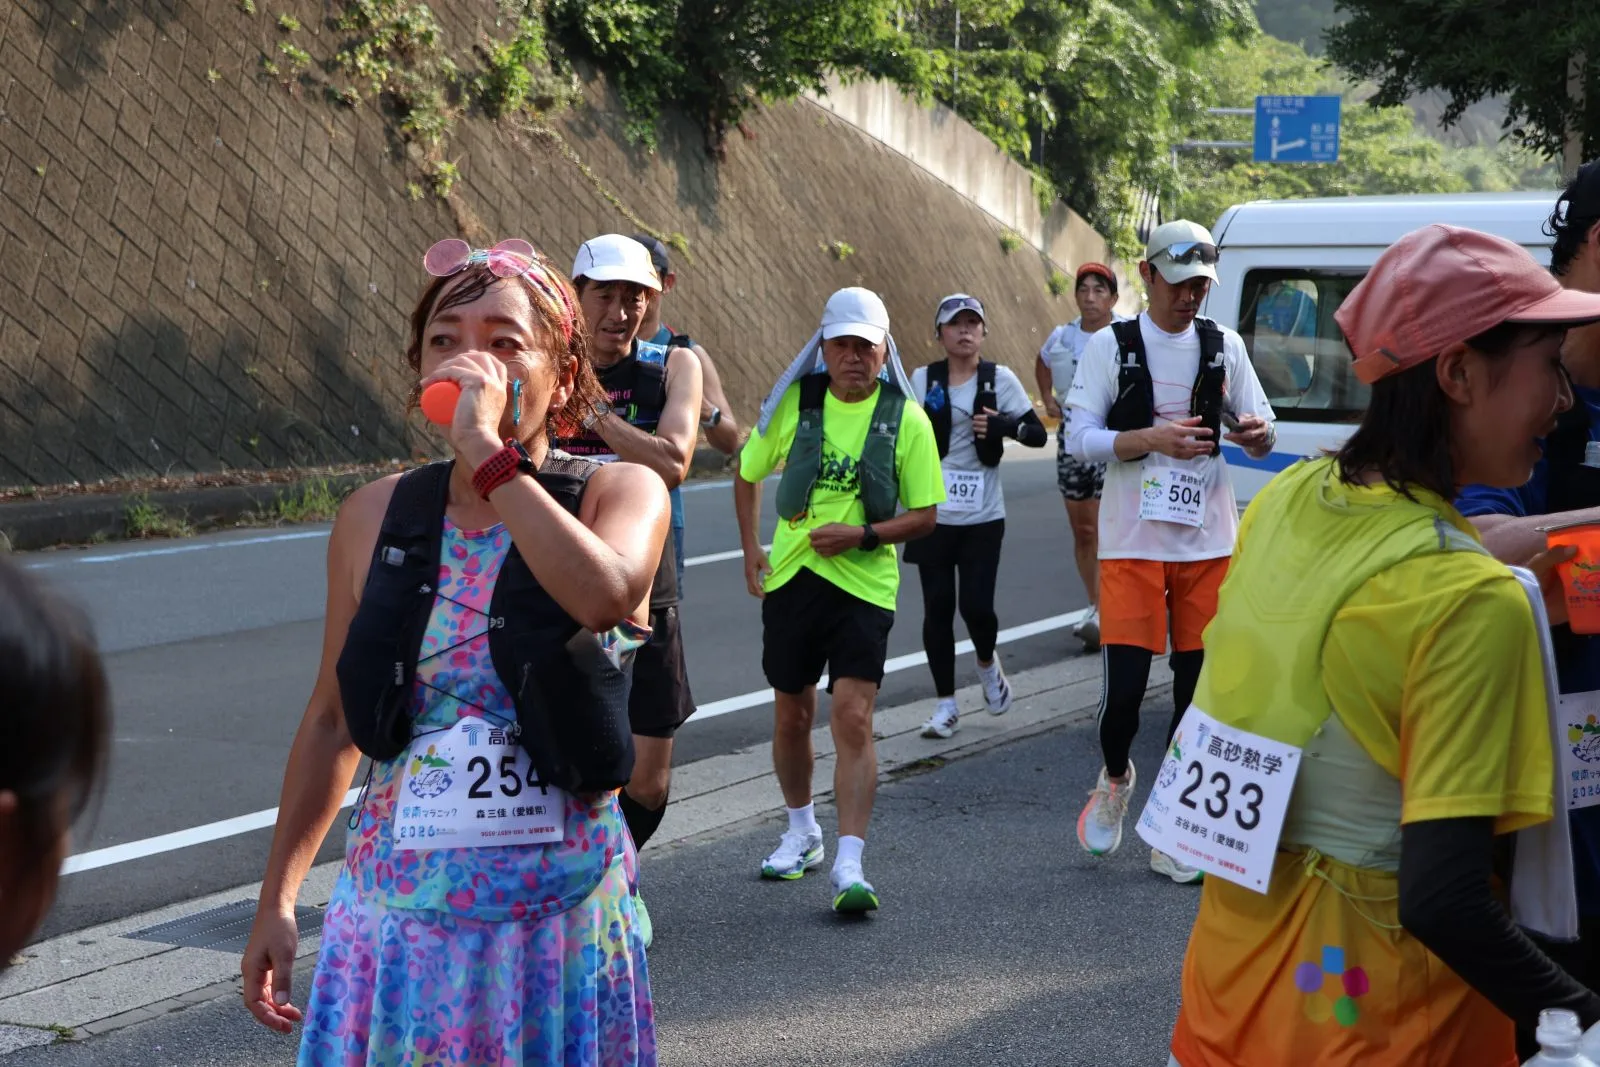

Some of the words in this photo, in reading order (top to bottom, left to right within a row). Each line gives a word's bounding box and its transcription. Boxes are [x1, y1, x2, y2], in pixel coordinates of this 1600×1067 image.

[949, 483, 978, 498] 497
[1168, 485, 1201, 508] 504
[1207, 734, 1283, 776] 高砂熱学
[467, 755, 549, 799] 254
[1179, 760, 1263, 831] 233
